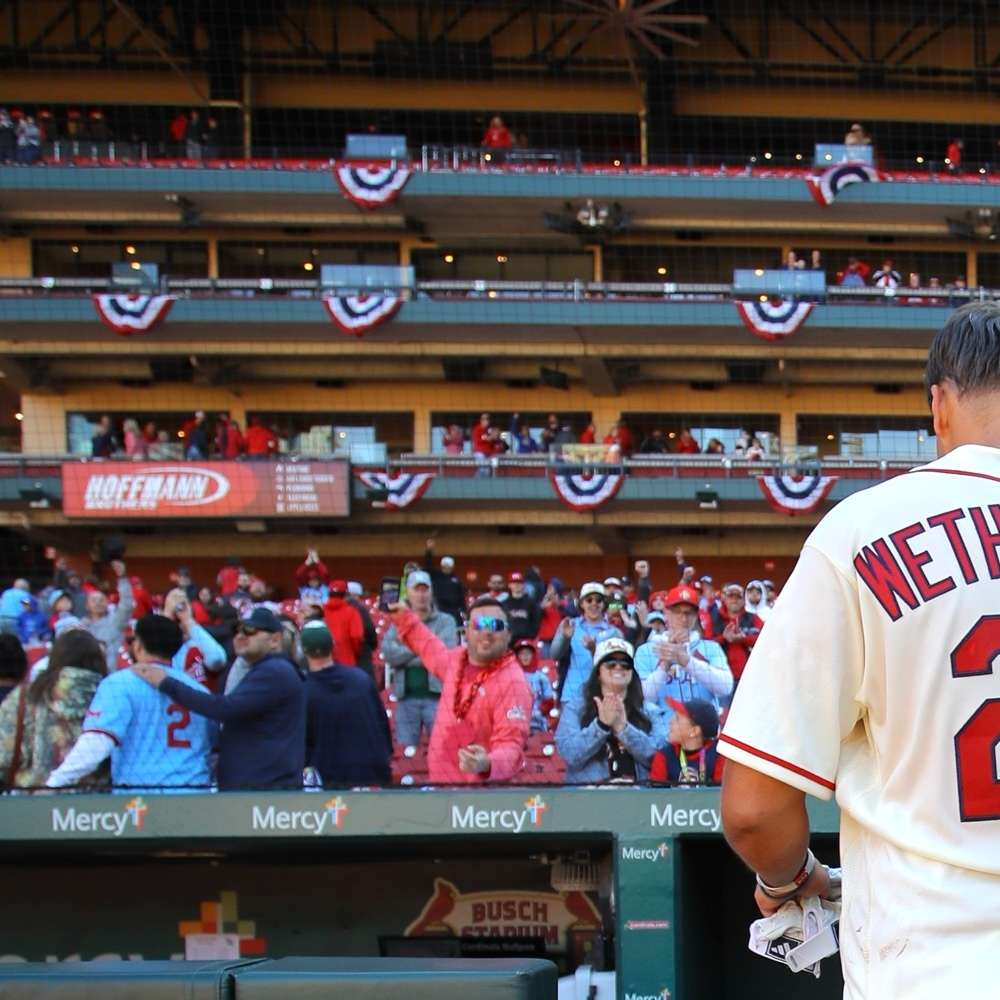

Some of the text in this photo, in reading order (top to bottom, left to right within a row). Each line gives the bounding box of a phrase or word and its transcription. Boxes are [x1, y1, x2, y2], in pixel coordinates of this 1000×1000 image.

[85, 474, 209, 501] HOFFMANN
[166, 704, 192, 748] 2
[51, 808, 129, 836] Mercy
[252, 805, 328, 834] Mercy
[451, 804, 527, 833] Mercy
[622, 848, 660, 862] Mercy
[471, 901, 549, 923] BUSCH
